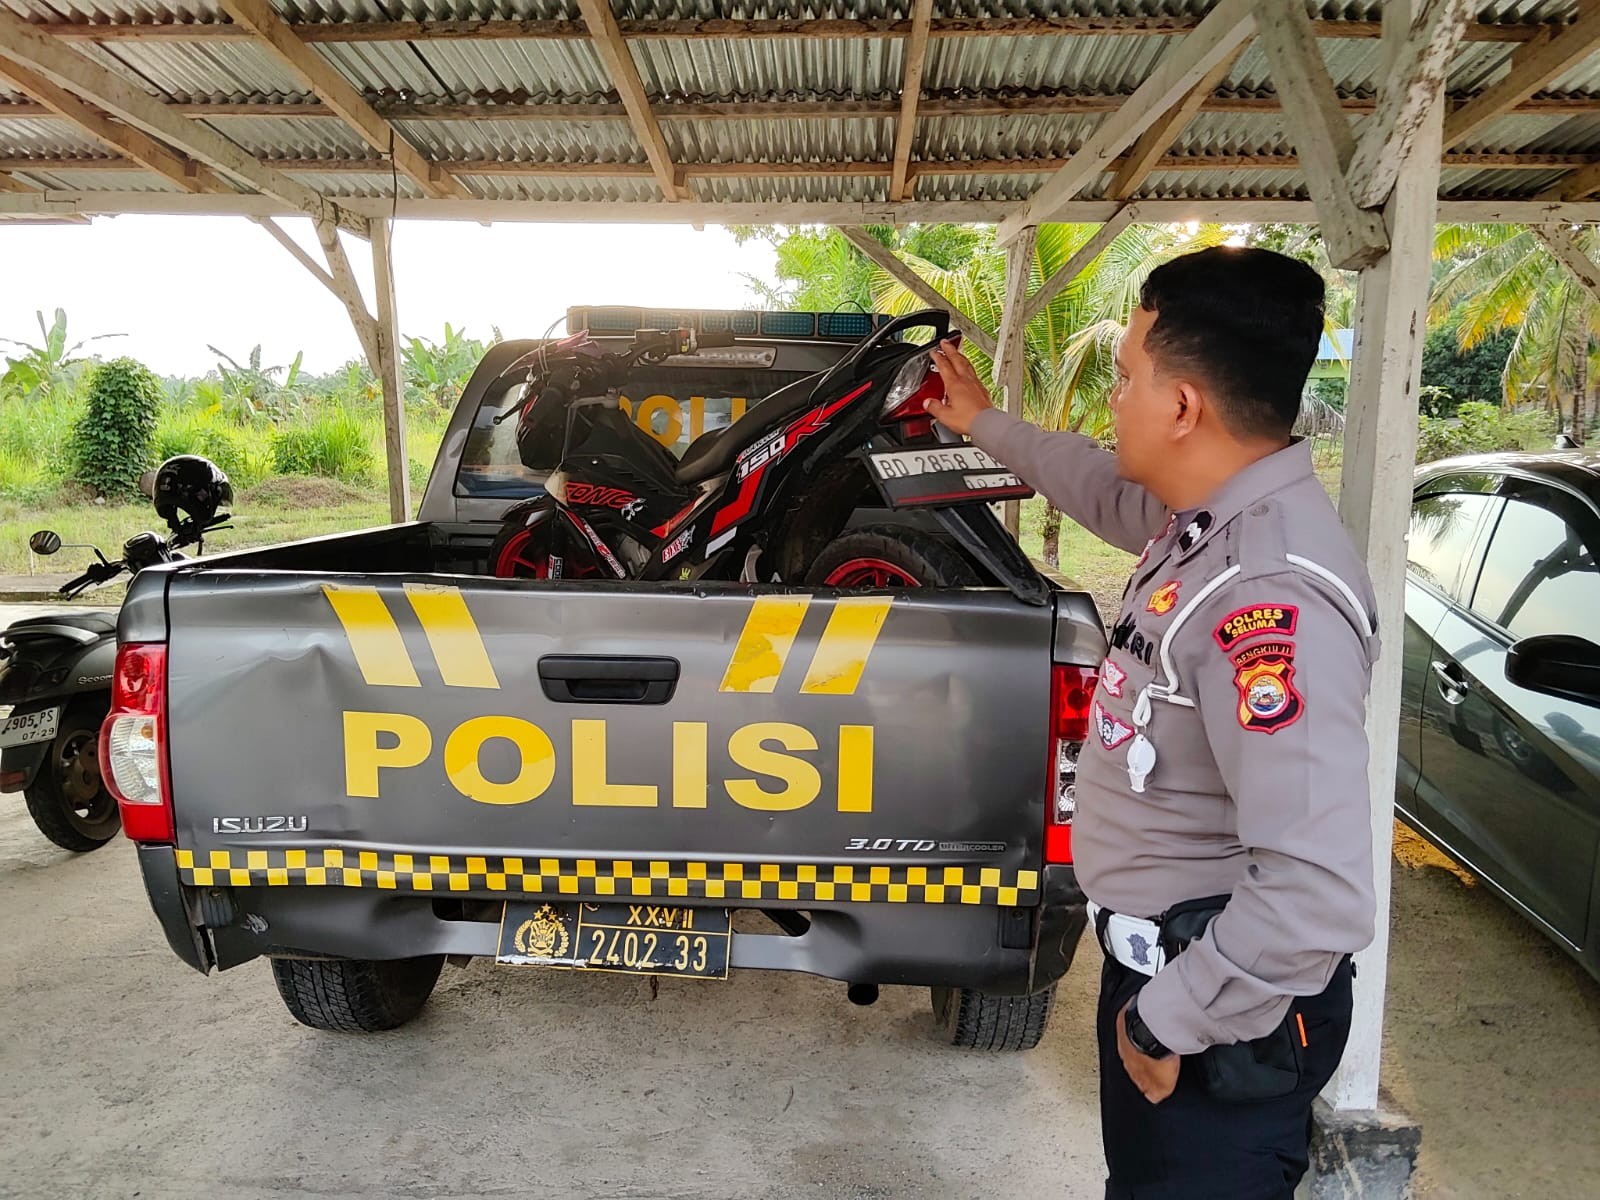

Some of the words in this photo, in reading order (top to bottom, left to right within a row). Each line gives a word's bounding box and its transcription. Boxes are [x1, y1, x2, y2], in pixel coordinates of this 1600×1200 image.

[879, 457, 910, 479] BD
[914, 452, 968, 473] 2858
[1224, 608, 1283, 634] POLRES
[1232, 619, 1276, 638] SELUMA
[40, 709, 53, 723] PS
[342, 710, 873, 813] POLISI
[213, 815, 307, 834] ISUZU
[589, 929, 659, 969] 2402
[674, 935, 708, 971] 33
